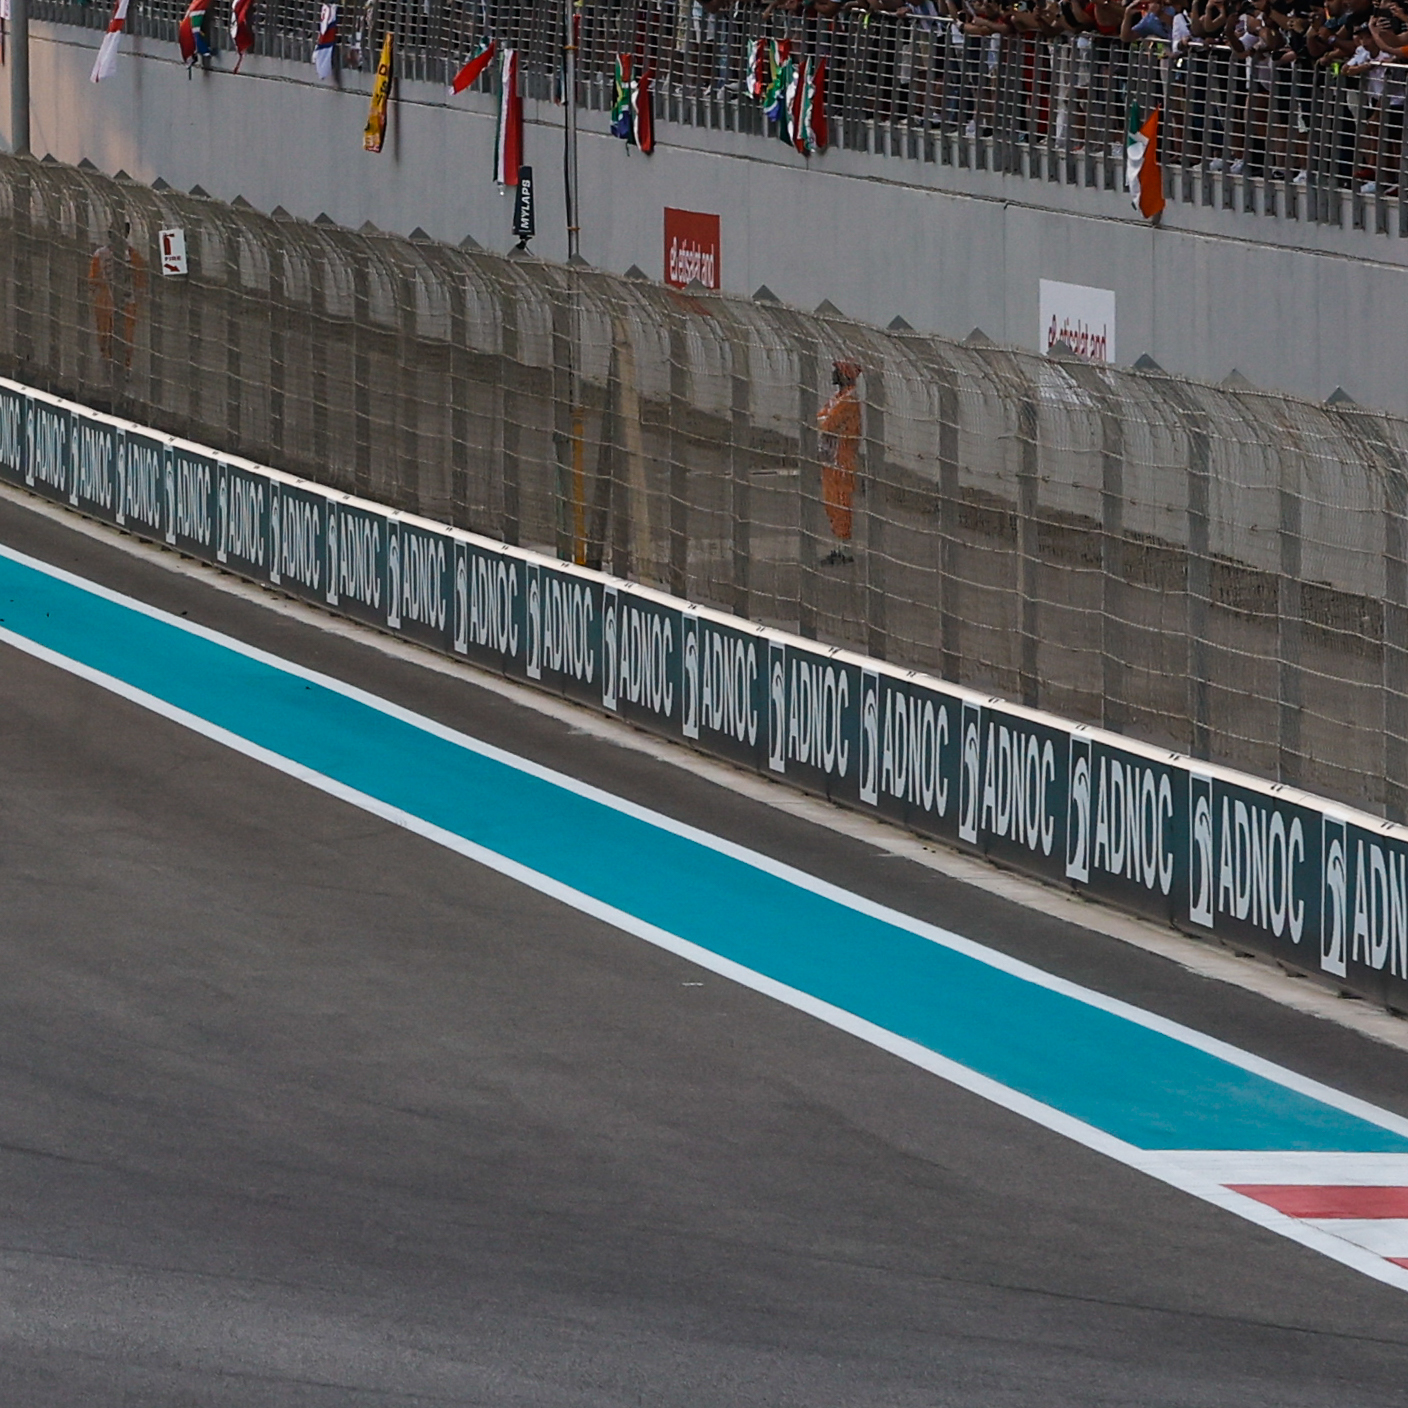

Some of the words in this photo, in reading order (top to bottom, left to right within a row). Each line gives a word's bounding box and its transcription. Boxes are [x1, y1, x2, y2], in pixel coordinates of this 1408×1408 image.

[519, 178, 532, 231] MYLAPS
[34, 404, 67, 493] ADNOC
[80, 419, 113, 511] ADNOC
[126, 434, 161, 530] ADNOC
[175, 458, 212, 547] ADNOC
[228, 473, 265, 568] ADNOC
[282, 489, 320, 591] ADNOC
[339, 507, 381, 610] ADNOC
[401, 532, 447, 633] ADNOC
[469, 552, 519, 658] ADNOC
[542, 577, 594, 684] ADNOC
[619, 604, 674, 719] ADNOC
[701, 630, 758, 748] ADNOC
[787, 657, 850, 779] ADNOC
[880, 687, 950, 818] ADNOC
[980, 721, 1056, 858] ADNOC
[1093, 755, 1174, 896] ADNOC
[1217, 794, 1306, 945] ADNOC
